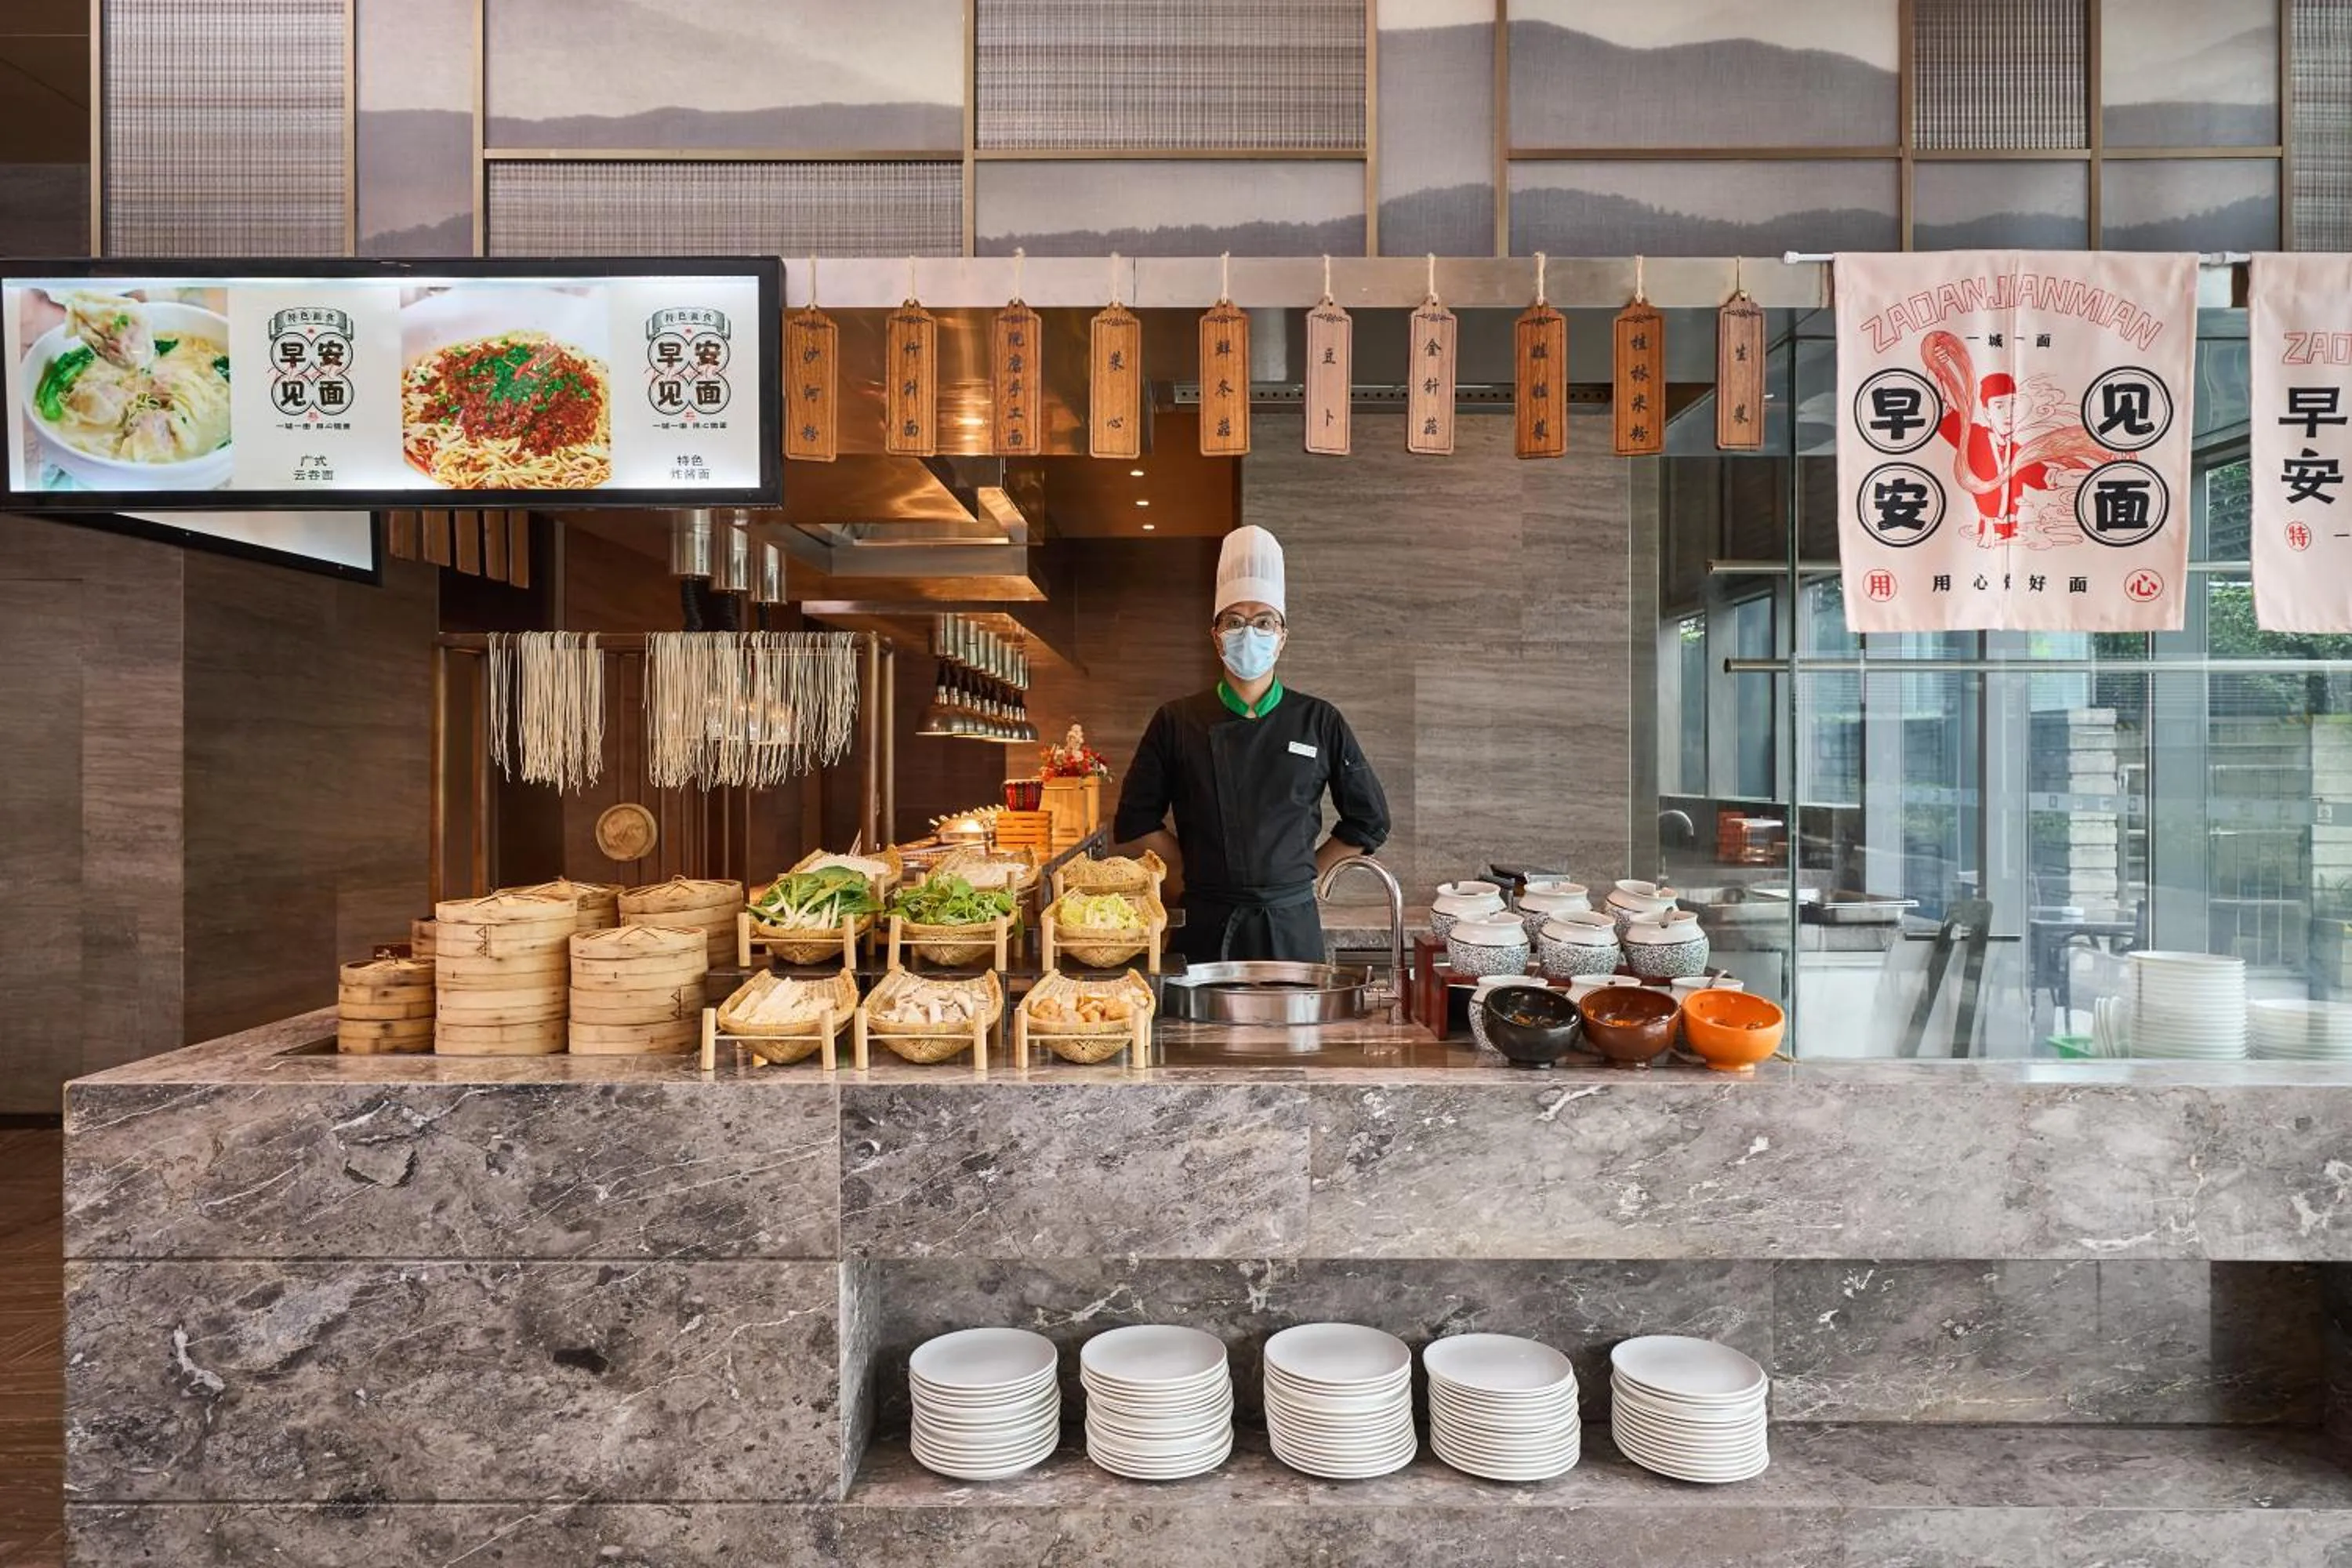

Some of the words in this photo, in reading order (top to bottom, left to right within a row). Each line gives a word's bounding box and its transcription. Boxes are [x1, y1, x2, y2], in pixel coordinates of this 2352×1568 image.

[280, 340, 344, 367] 早安
[657, 340, 720, 367] 早安
[281, 380, 344, 407] 见面
[658, 380, 721, 407] 见面
[1107, 350, 1124, 429] 菜心
[1322, 348, 1336, 427] 豆卜
[1630, 332, 1650, 442] 桂林米粉
[1733, 343, 1748, 424] 生菜
[2278, 387, 2348, 504] 早安
[300, 456, 327, 466] 广式
[677, 454, 703, 466] 特色
[293, 470, 333, 481] 云吞面
[2288, 525, 2308, 548] 特
[1869, 574, 1891, 597] 用
[2129, 574, 2158, 597] 心
